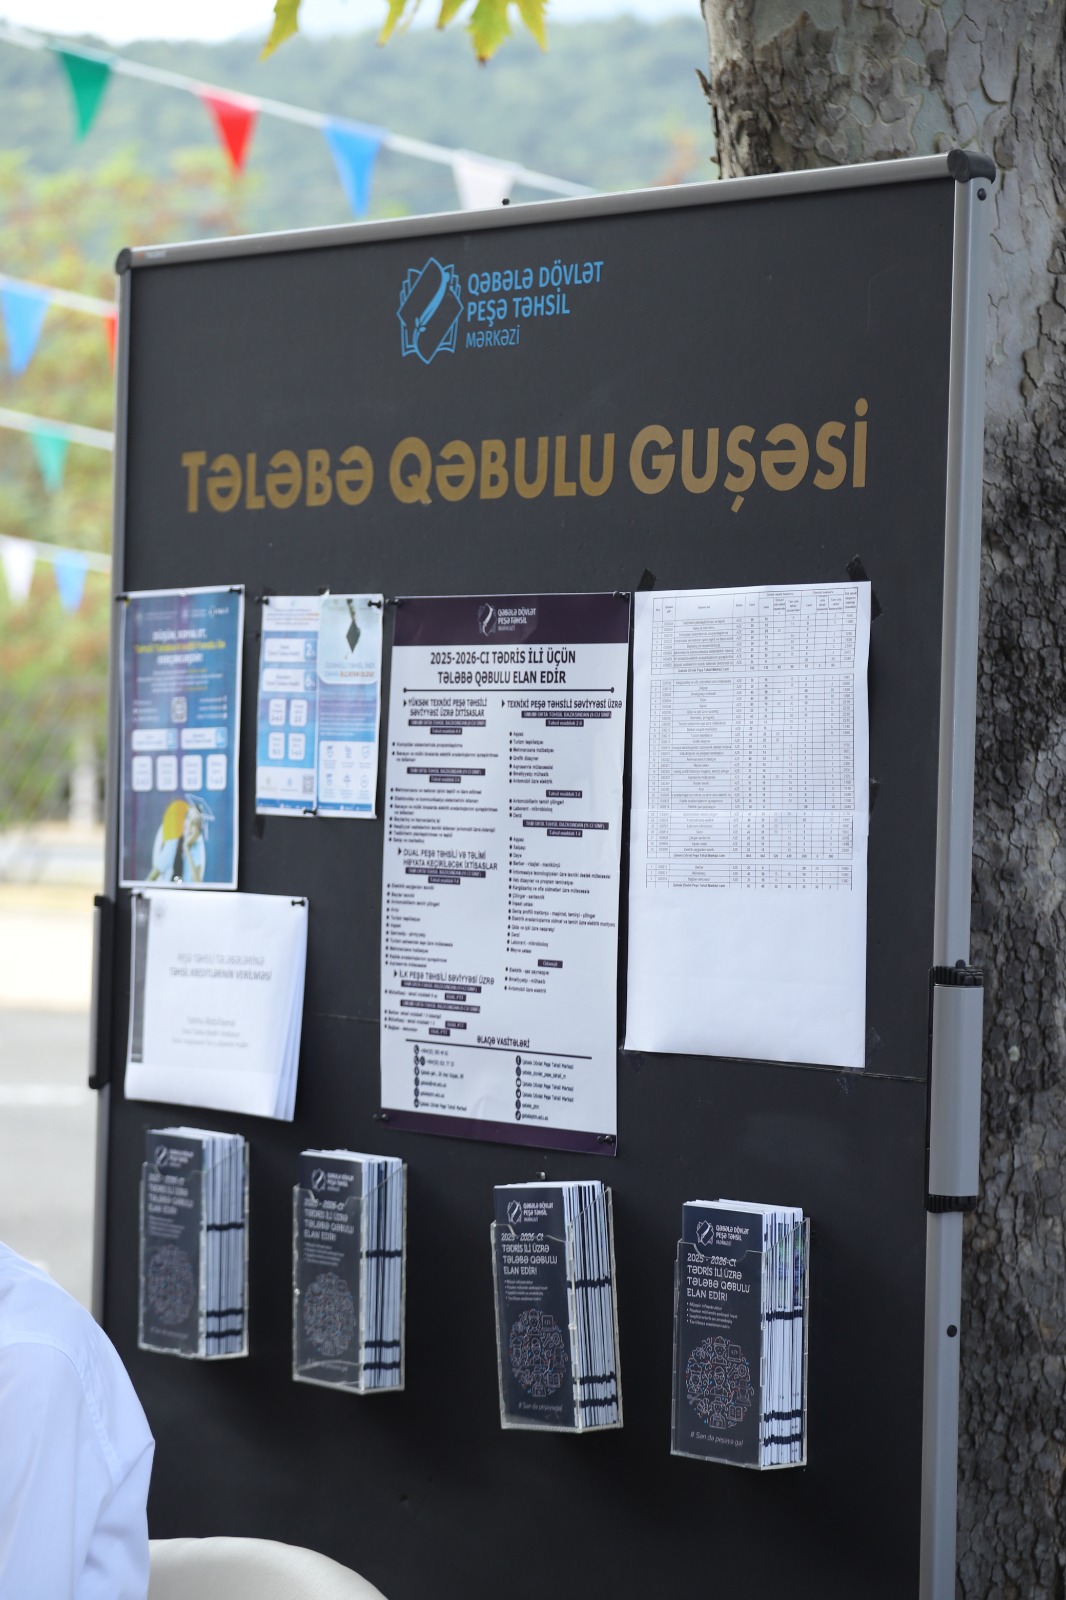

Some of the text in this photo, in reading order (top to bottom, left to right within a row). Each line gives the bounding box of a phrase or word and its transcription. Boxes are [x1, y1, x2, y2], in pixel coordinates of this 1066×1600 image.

[468, 259, 604, 296] QƏBƏLƏ DÖVLƏT
[467, 287, 570, 327] PEŞƏ TƏHSİL
[466, 324, 521, 348] MƏRKƏZİ
[181, 397, 869, 514] TƏLƏBƏ QƏBULU GUŞƏSİ
[492, 649, 526, 664] TƏDRİS
[546, 649, 576, 668] ÜÇÜN
[438, 667, 566, 687] TƏLƏBƏ QƏBULU ELAN EDİR
[688, 1253, 704, 1263] 2025
[687, 1264, 712, 1276] TƏDRİS
[724, 1269, 742, 1280] ÜZRƏ
[687, 1276, 750, 1294] TƏLƏBƏ QƏBULU
[687, 1288, 706, 1298] ELAN
